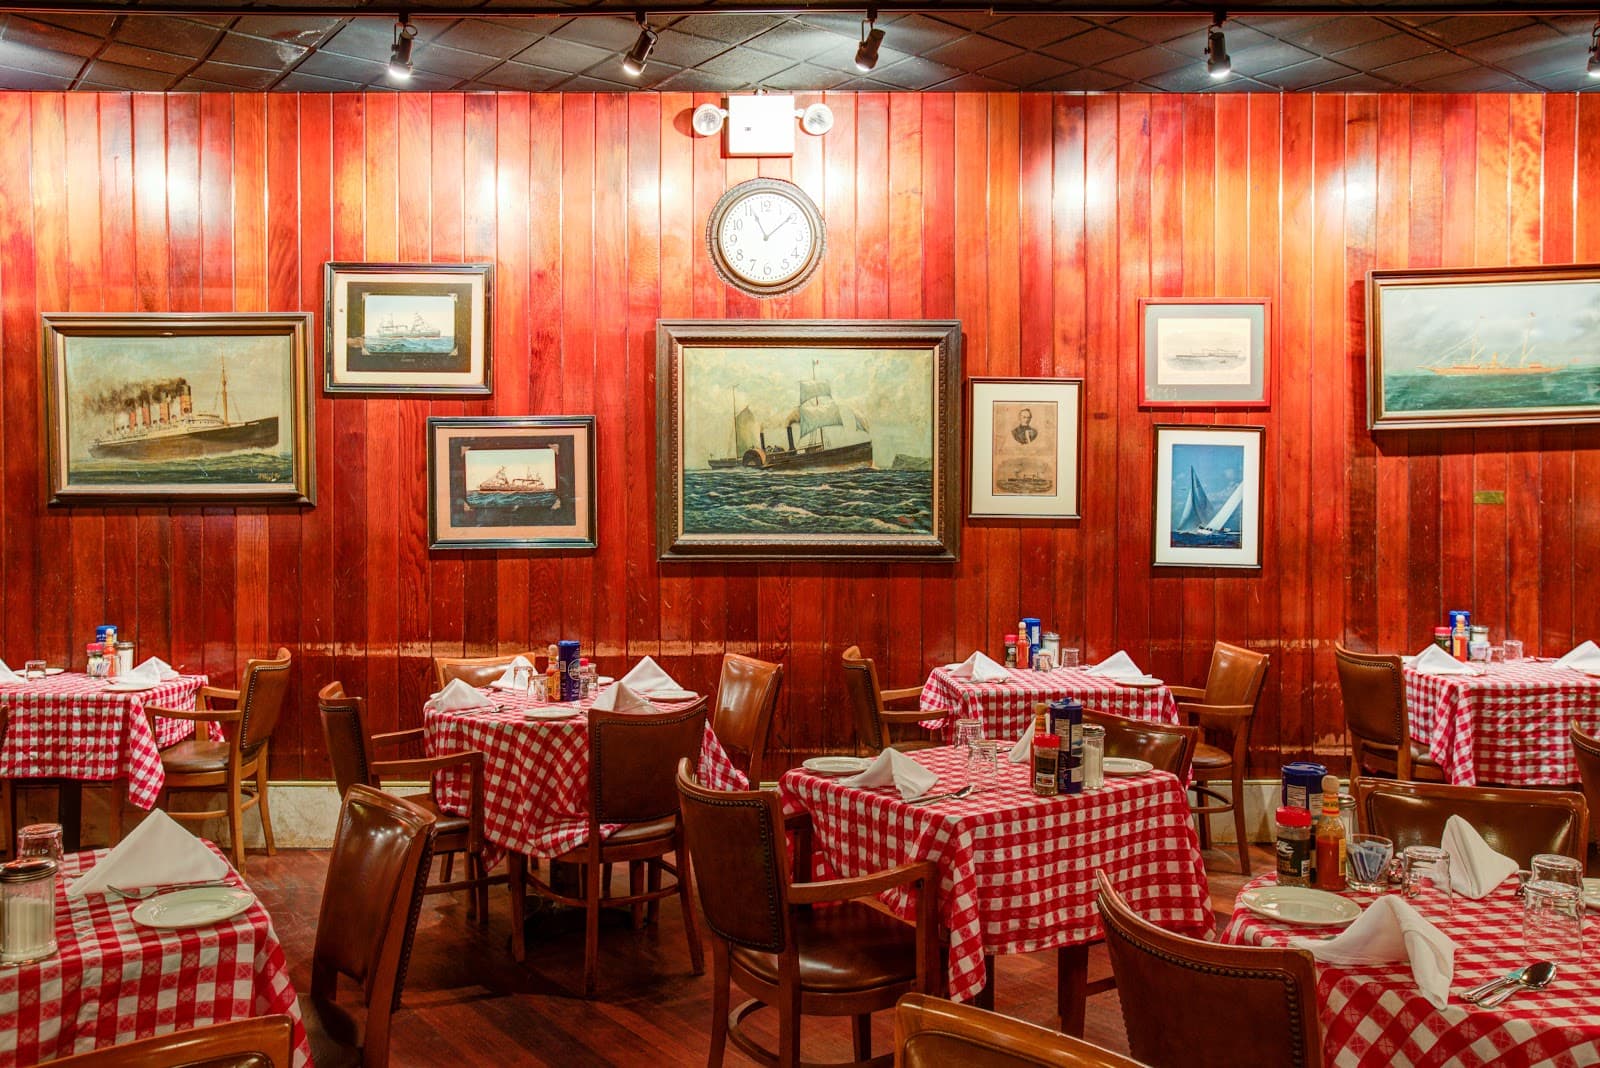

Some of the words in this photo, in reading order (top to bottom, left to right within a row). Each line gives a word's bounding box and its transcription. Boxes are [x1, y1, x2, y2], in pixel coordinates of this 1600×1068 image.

[745, 203, 752, 216] 11
[760, 200, 771, 212] 12
[790, 212, 798, 224] 2
[733, 218, 743, 231] 10
[729, 234, 738, 246] 9
[795, 230, 803, 242] 3
[736, 248, 744, 261] 8
[790, 247, 800, 259] 4
[749, 258, 757, 271] 7
[763, 262, 772, 275] 6
[781, 258, 790, 270] 5
